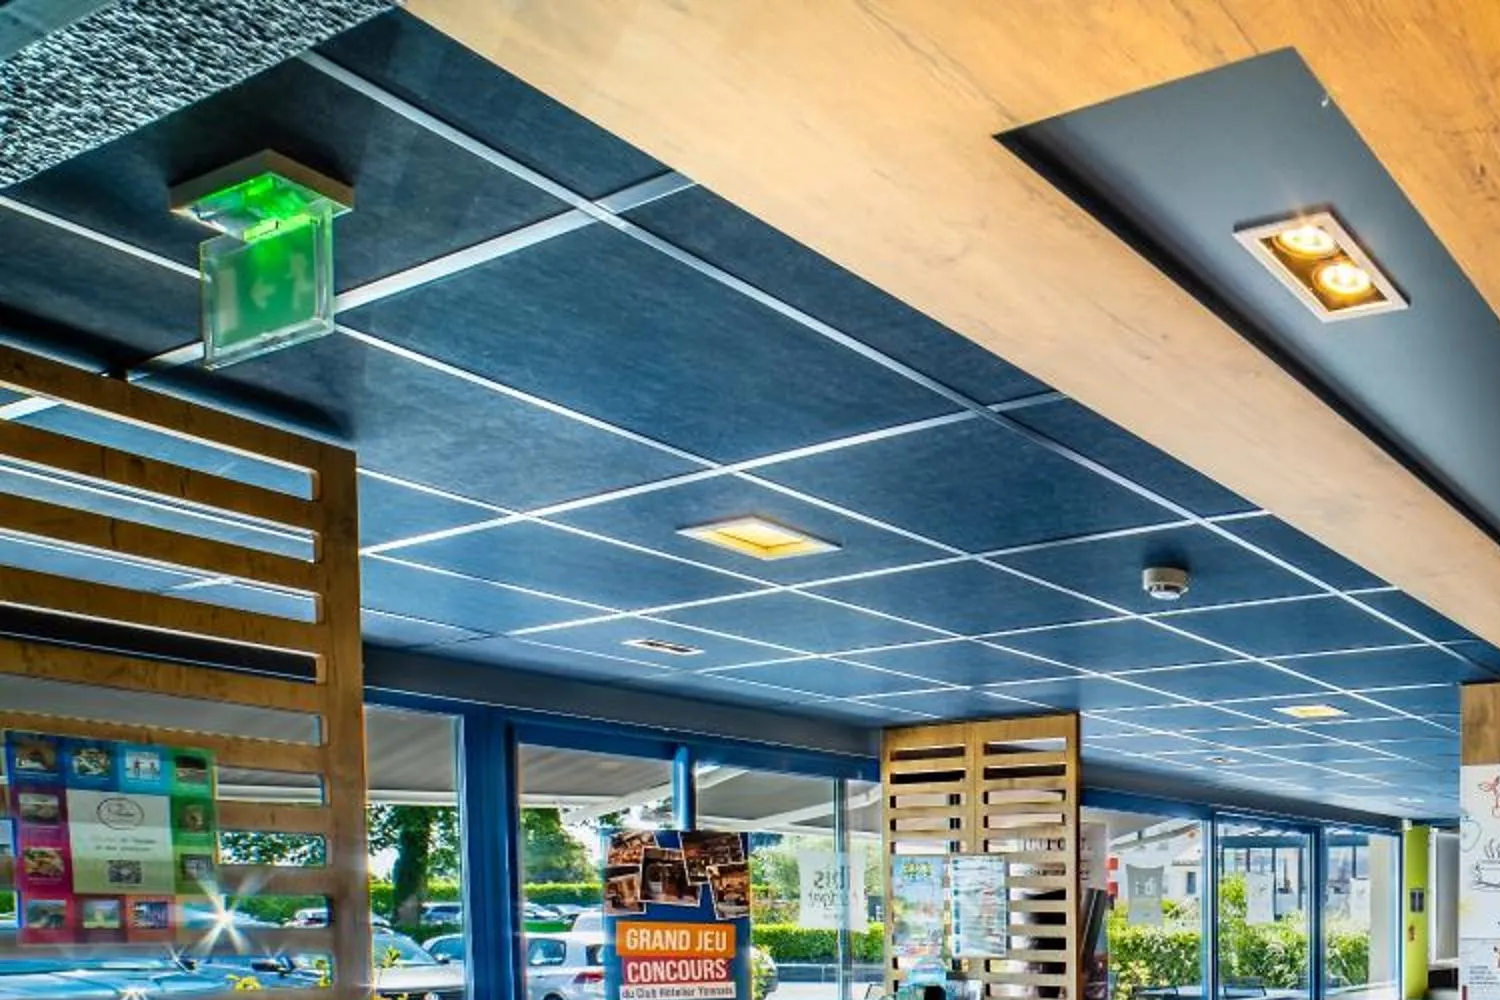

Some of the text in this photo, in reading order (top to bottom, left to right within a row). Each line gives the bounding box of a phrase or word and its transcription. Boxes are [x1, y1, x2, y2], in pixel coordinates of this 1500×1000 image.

[626, 928, 727, 952] GRAND JEU
[627, 958, 727, 983] CONCOURS
